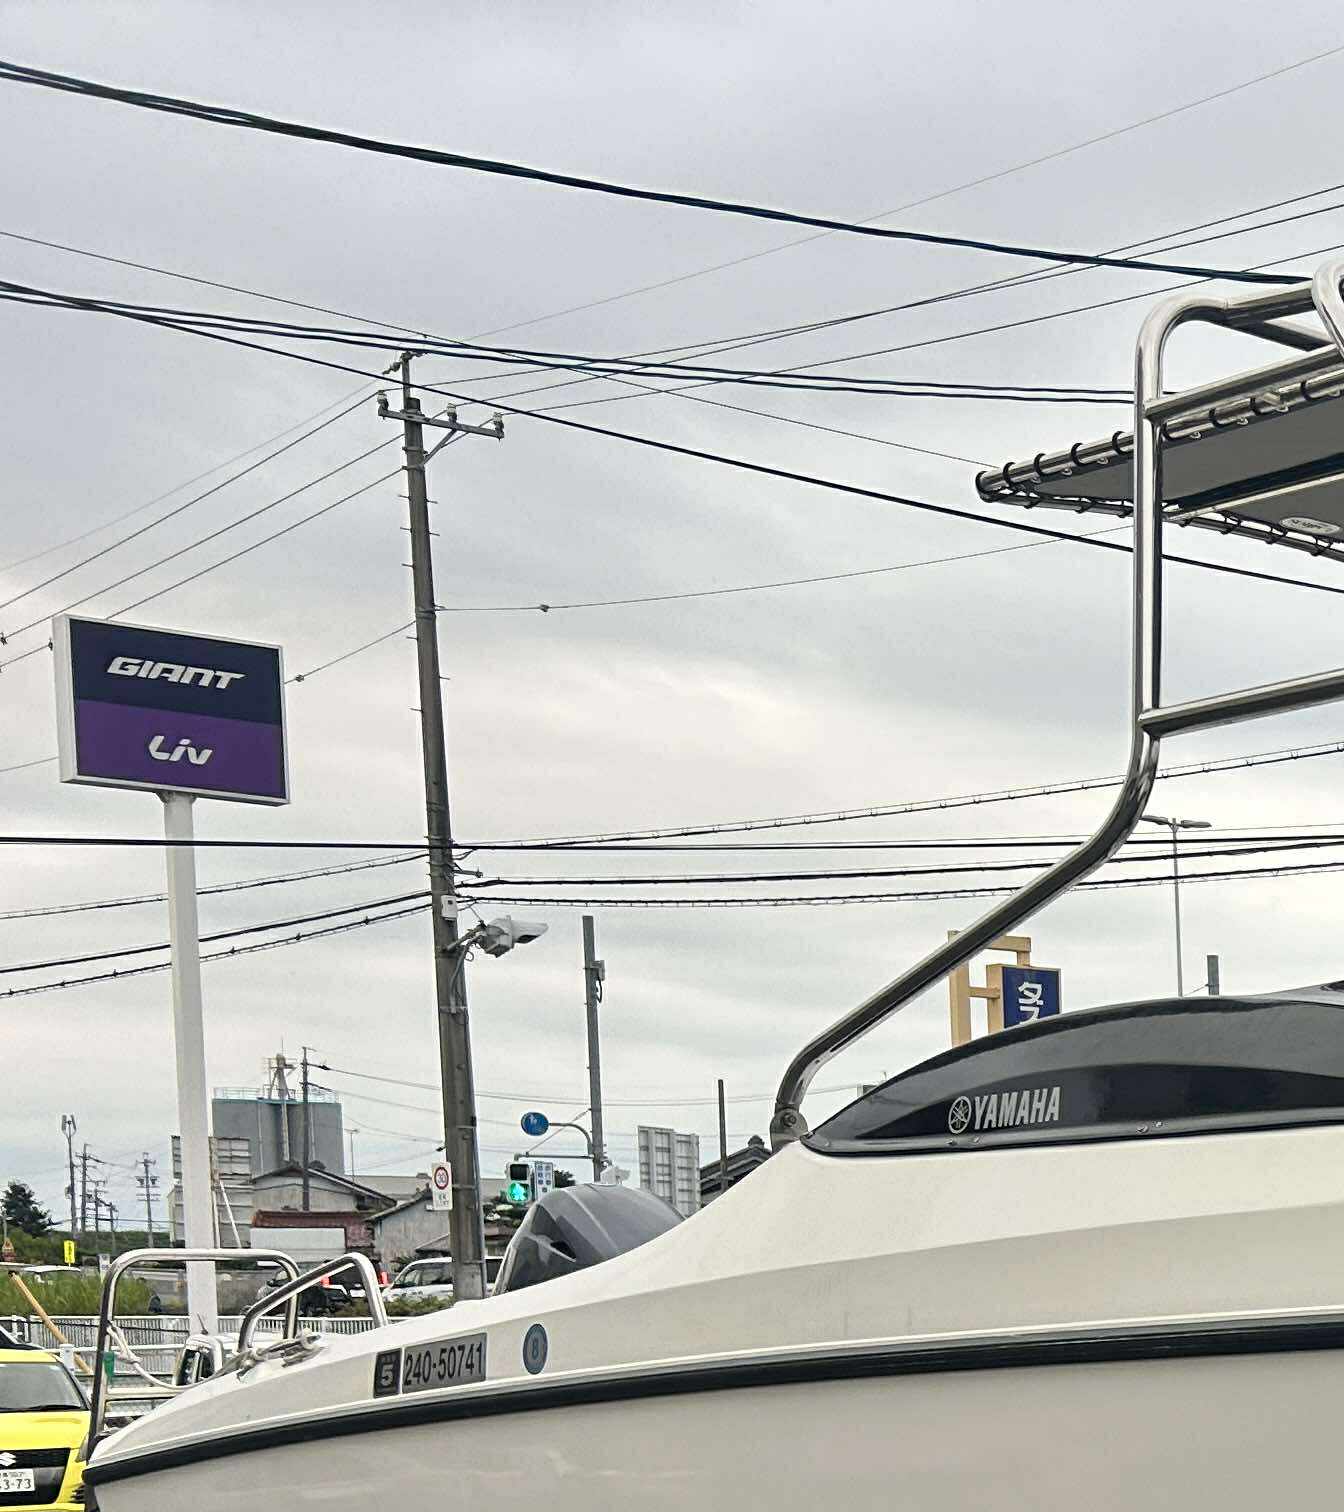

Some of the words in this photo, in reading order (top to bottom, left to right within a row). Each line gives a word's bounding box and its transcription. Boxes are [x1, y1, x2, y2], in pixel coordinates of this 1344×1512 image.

[106, 656, 246, 690] GIANT
[148, 735, 213, 766] Liv
[974, 1086, 1061, 1131] YAMAHA
[403, 1341, 483, 1387] 240-50741
[0, 1478, 32, 1491] 3-73
